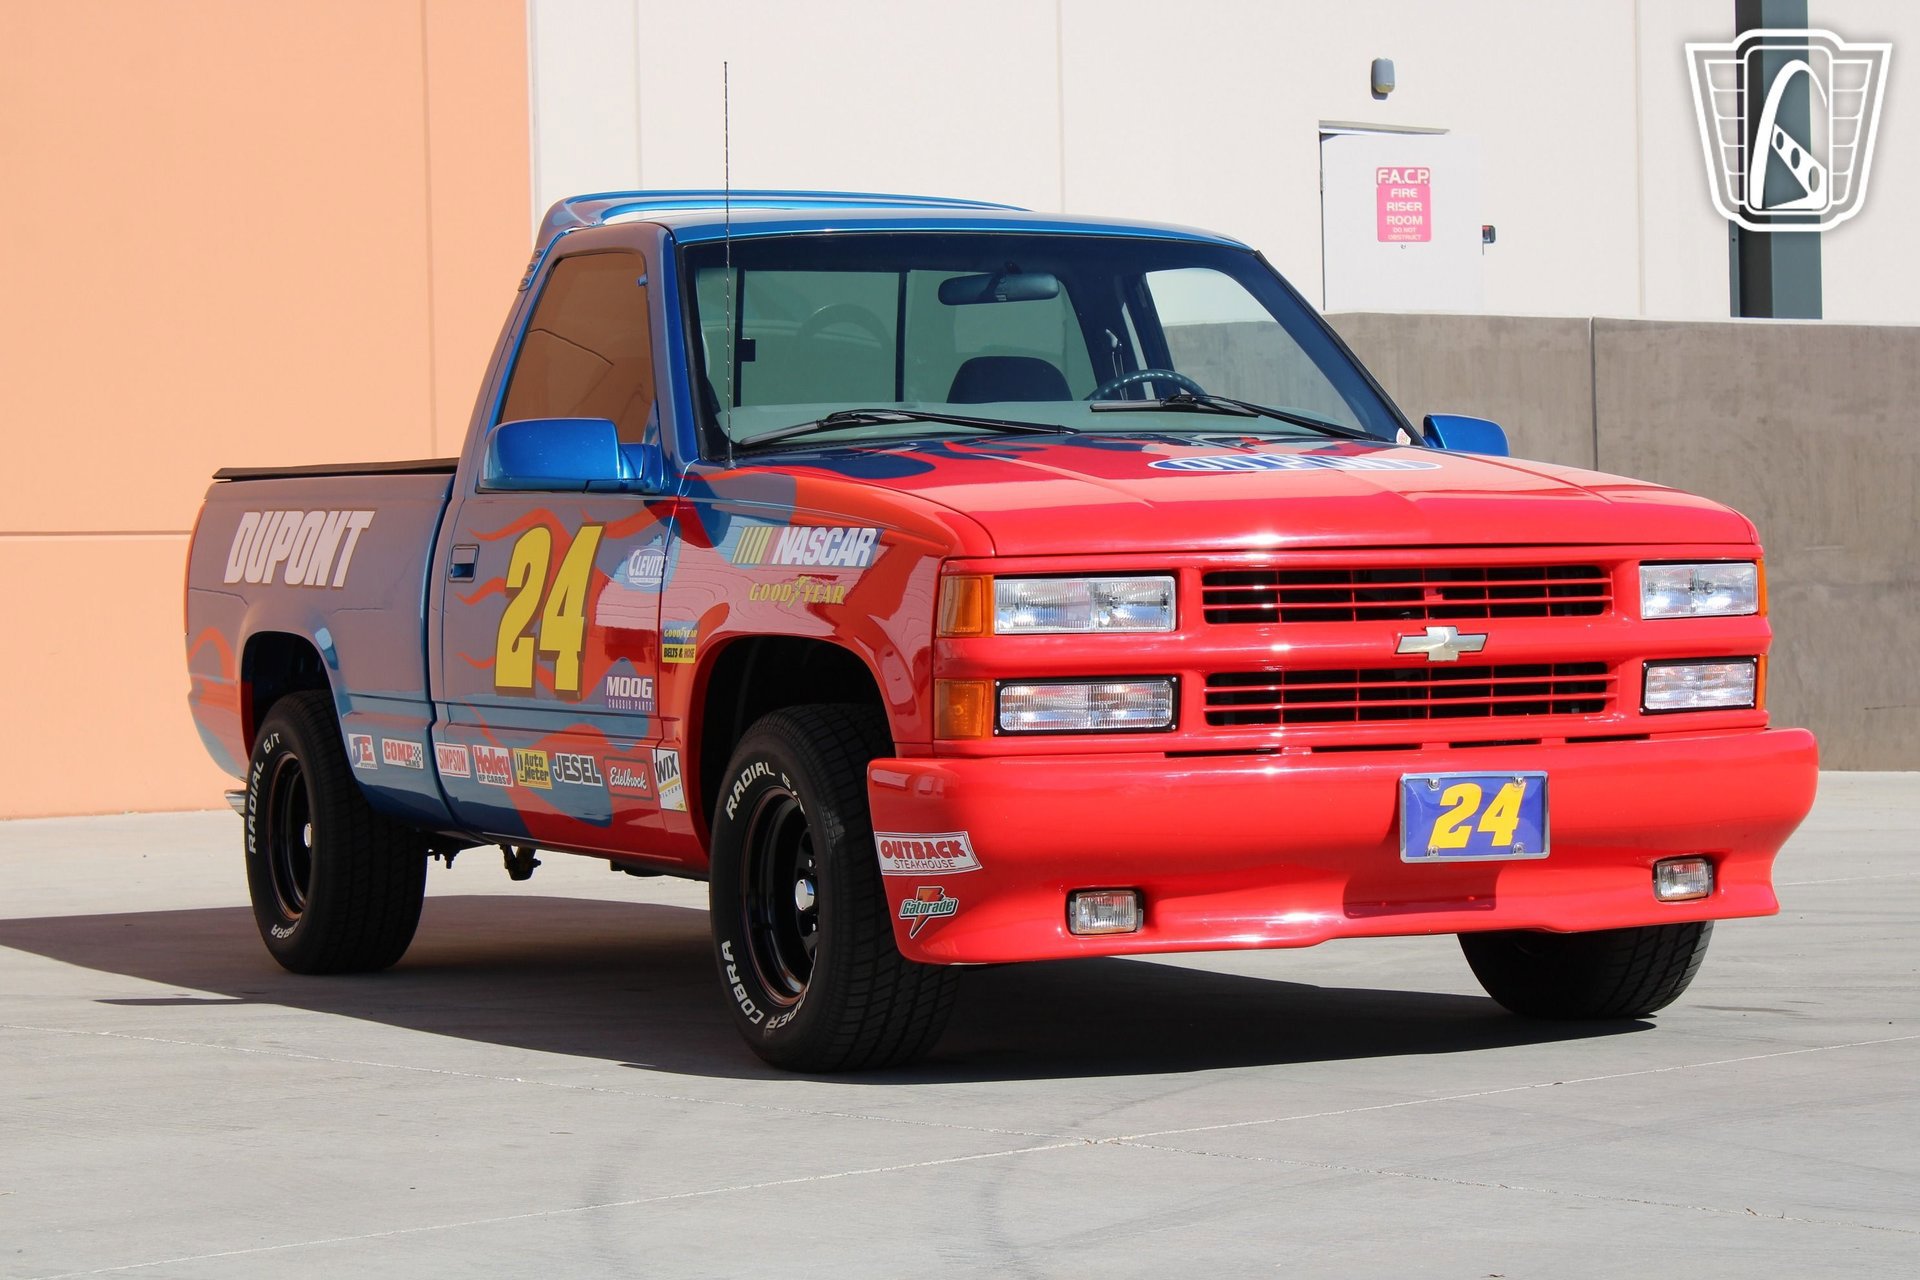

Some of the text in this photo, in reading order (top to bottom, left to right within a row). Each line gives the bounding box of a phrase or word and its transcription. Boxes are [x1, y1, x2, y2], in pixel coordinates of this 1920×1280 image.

[1390, 188, 1418, 198] FIRE
[1386, 202, 1423, 212] RISER
[1386, 215, 1423, 225] ROOM
[223, 510, 376, 588] DUPONT
[771, 526, 878, 567] NASCAR
[495, 525, 606, 692] 24
[664, 648, 678, 658] BELTS
[606, 676, 653, 699] MOOG
[608, 699, 652, 711] CHASSIS PARTS
[384, 741, 413, 761] COMP
[438, 749, 467, 772] SIMPSON
[524, 753, 544, 767] Auto
[474, 746, 512, 785] Holley
[524, 766, 549, 781] Meter
[553, 753, 602, 786] JESEL
[656, 753, 679, 783] WIX
[609, 767, 647, 790] Edelbrock
[248, 733, 281, 854] RADIAL G/T
[726, 761, 775, 821] RADIAL
[1428, 782, 1527, 849] 24
[880, 840, 967, 859] OUTBACK
[894, 859, 957, 869] STEAKHOUSE
[902, 900, 955, 914] Gatorade
[721, 940, 764, 1025] COBRA
